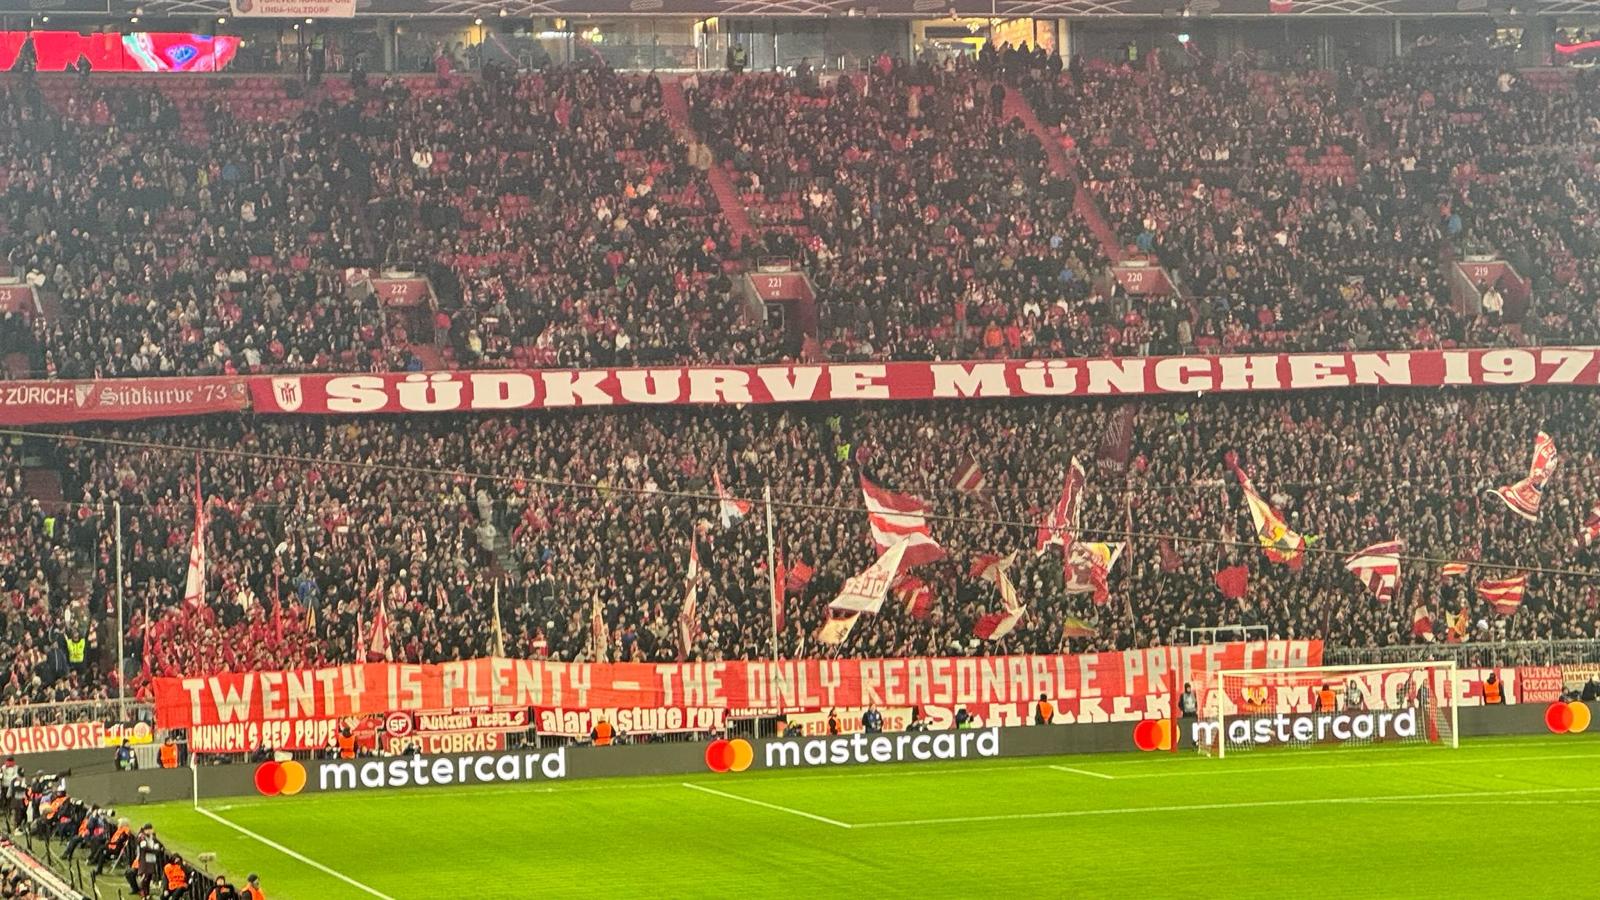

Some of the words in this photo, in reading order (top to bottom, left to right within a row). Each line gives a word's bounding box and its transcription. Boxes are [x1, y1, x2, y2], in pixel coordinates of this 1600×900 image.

[768, 277, 782, 288] 221
[1127, 272, 1143, 282] 220
[1474, 266, 1488, 276] 219
[391, 283, 407, 294] 222
[325, 364, 890, 412] SÜDKURVE
[930, 352, 1411, 398] MÜNCHEN
[1442, 348, 1600, 384] 197
[100, 385, 194, 407] Südkurve
[1520, 667, 1562, 679] ULTRAS
[182, 663, 366, 725] TWENTY
[388, 663, 424, 710] IS
[443, 656, 592, 709] PLENTY
[655, 661, 728, 706] THE
[746, 657, 841, 707] ONLY
[859, 653, 1101, 704] REASONABLE
[1123, 646, 1227, 697] PRICE
[1521, 679, 1562, 691] GEGEN
[0, 721, 104, 754] OHRDORF
[191, 722, 258, 751] MUNICH'S
[295, 718, 338, 748] PRIDE
[391, 719, 408, 733] SF
[1191, 707, 1418, 746] mastercard
[429, 730, 498, 754] COBRAS
[764, 726, 1000, 766] mastercard
[319, 748, 567, 792] mastercard
